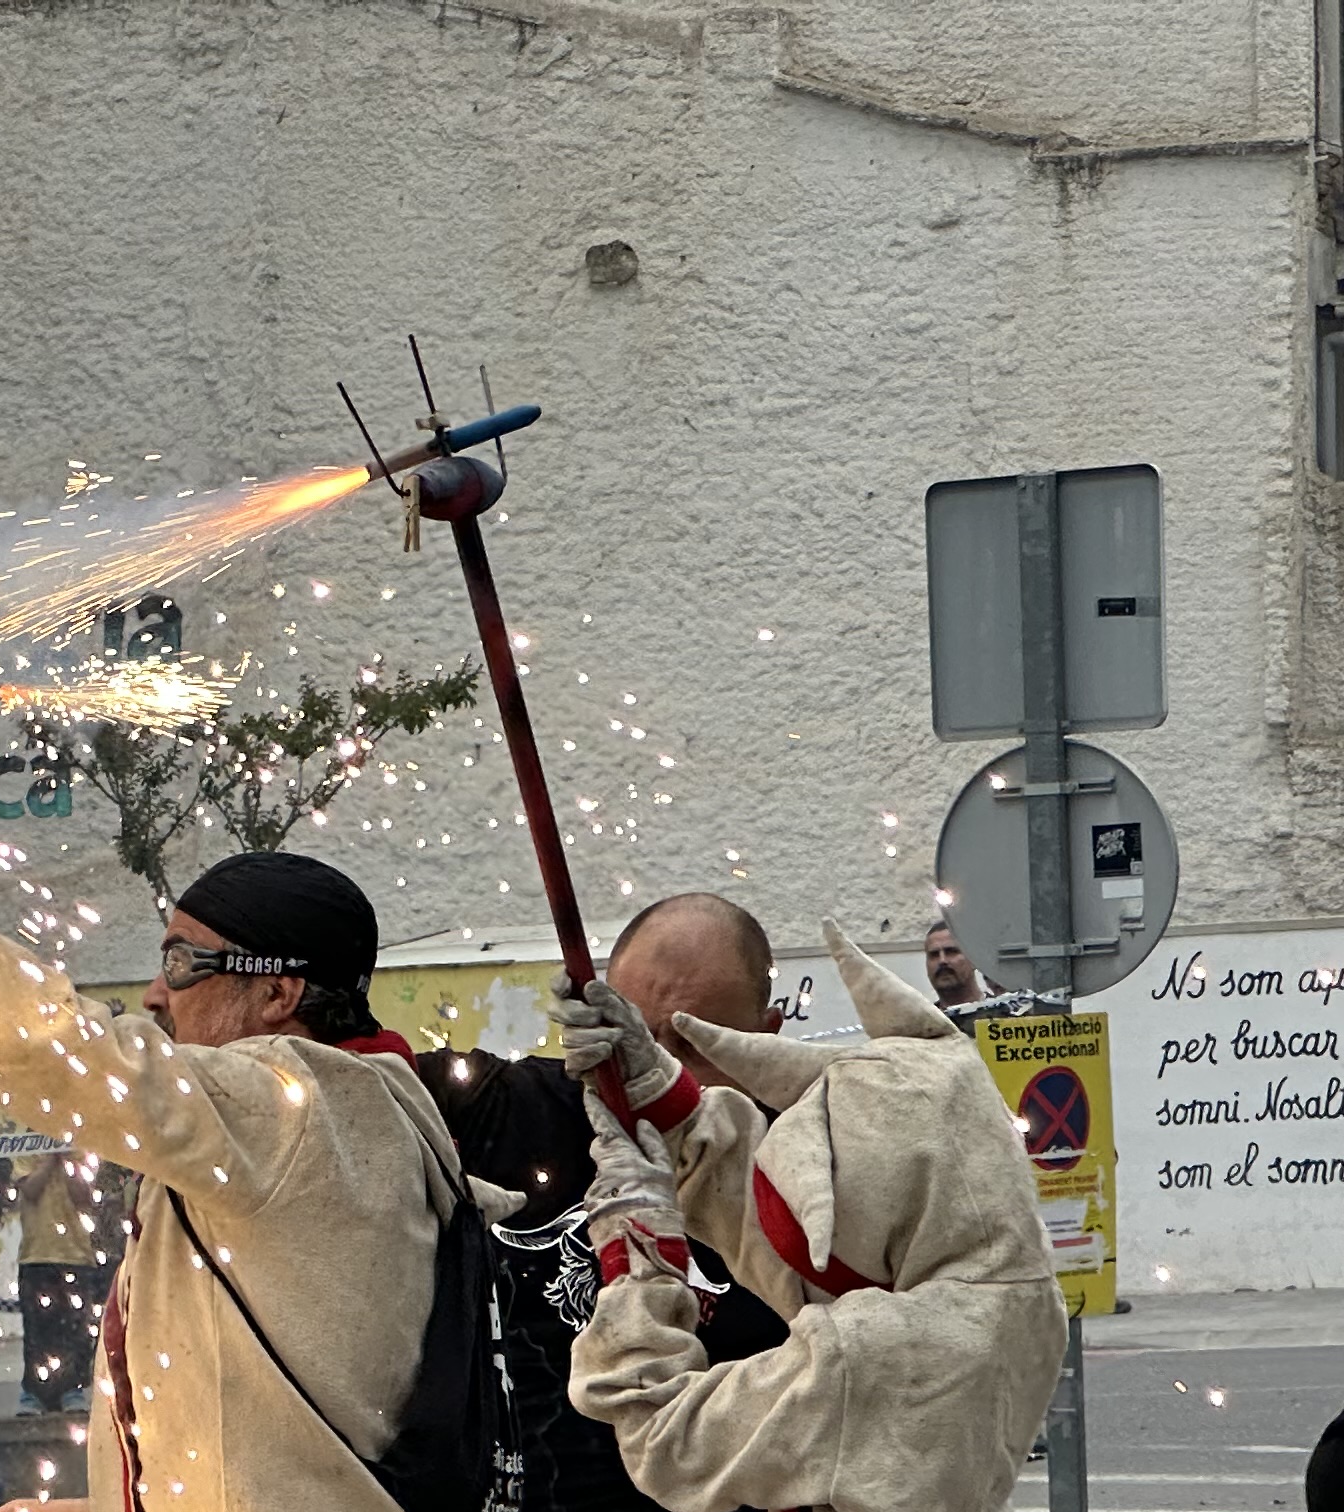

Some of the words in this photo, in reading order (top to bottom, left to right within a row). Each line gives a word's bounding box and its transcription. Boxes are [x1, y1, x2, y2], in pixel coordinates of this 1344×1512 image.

[225, 954, 283, 974] PEGASO
[1219, 969, 1284, 997] som
[995, 1039, 1100, 1064] Excepcional
[1157, 1033, 1218, 1079] per
[1230, 1019, 1340, 1061] buscar
[1155, 1091, 1250, 1126] somni.
[1158, 1160, 1212, 1189] som
[1223, 1142, 1260, 1187] el
